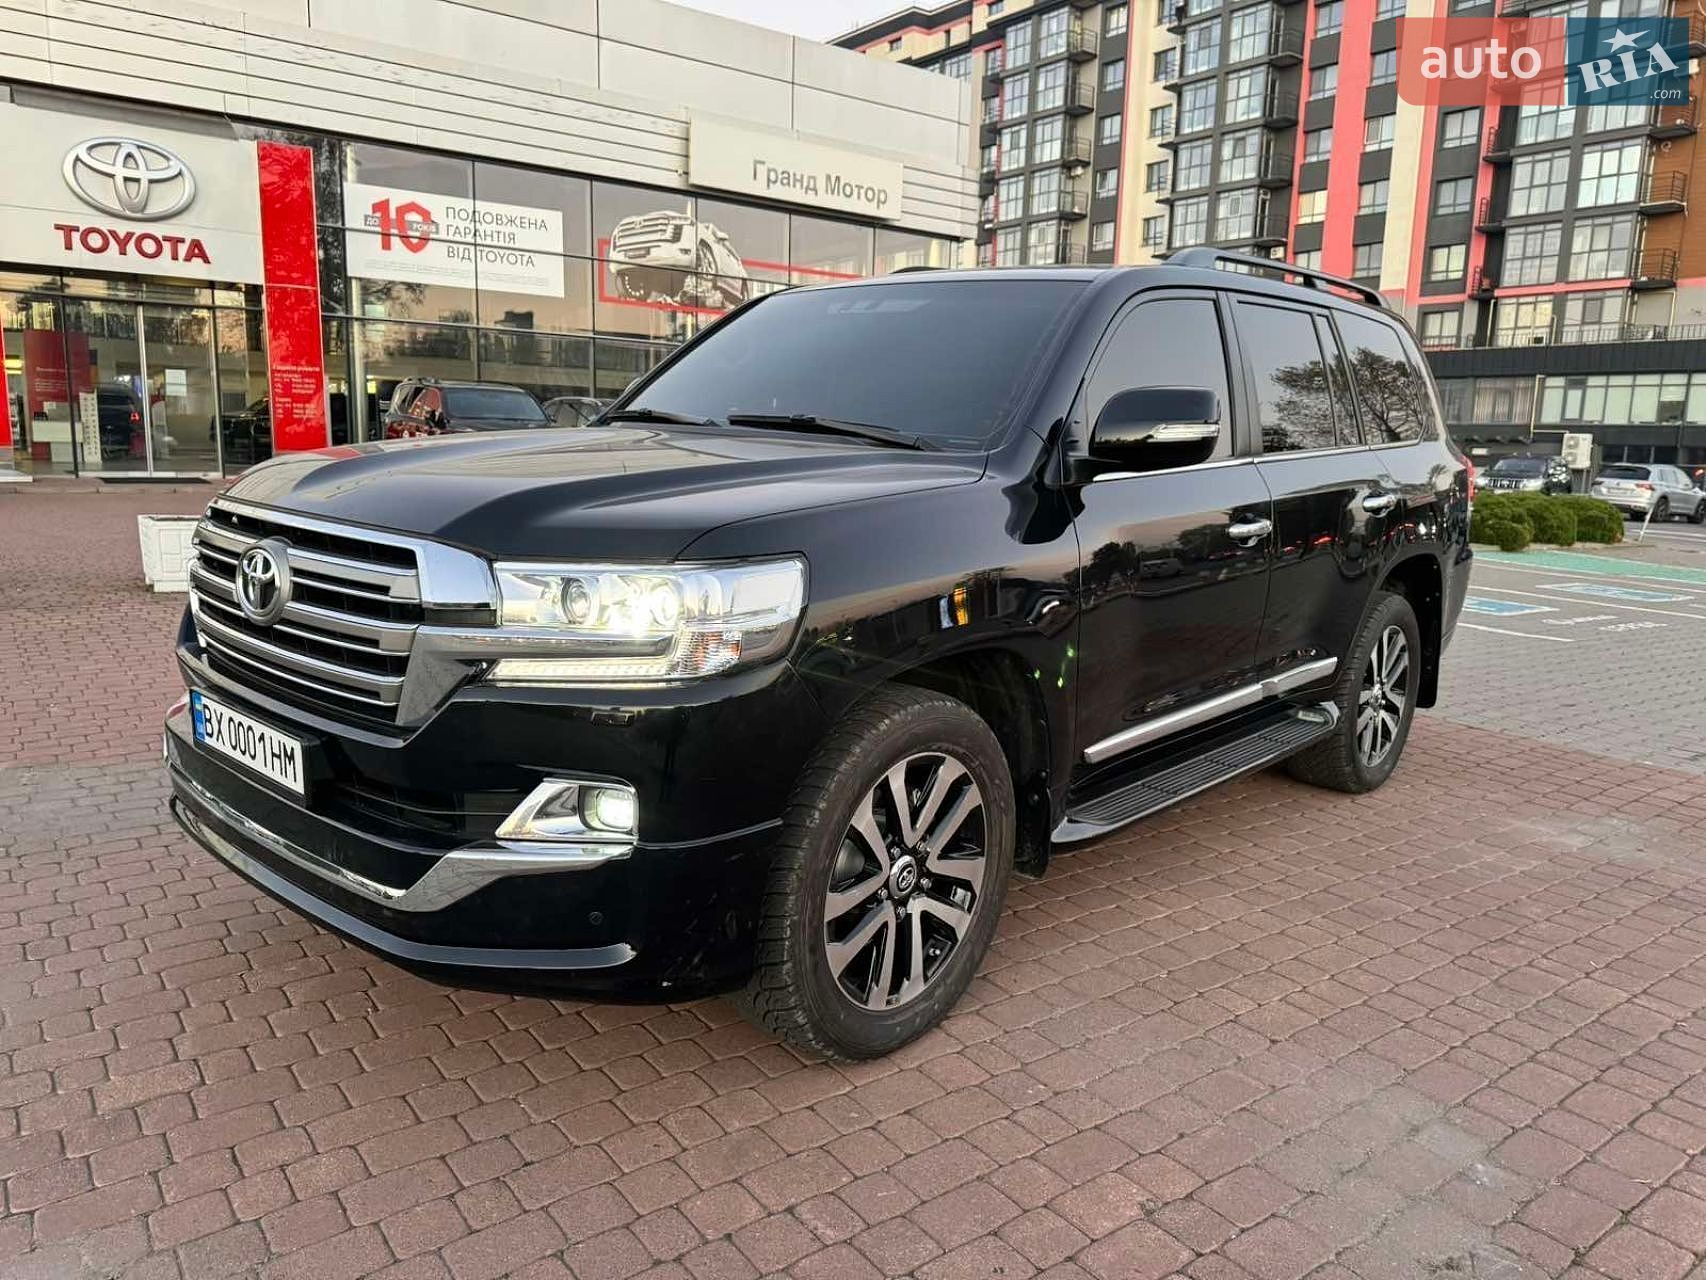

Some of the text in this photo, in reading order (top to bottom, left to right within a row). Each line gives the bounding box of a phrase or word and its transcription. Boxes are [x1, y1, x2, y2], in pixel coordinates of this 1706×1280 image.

[753, 159, 888, 209] Гранд Мотор
[371, 198, 432, 254] 10
[445, 206, 549, 232] ПОДОВЖЕНА
[446, 224, 517, 245] ГАРАНТІЯ
[54, 223, 212, 264] TOYOTA
[447, 246, 536, 268] ВІД TOYOTA
